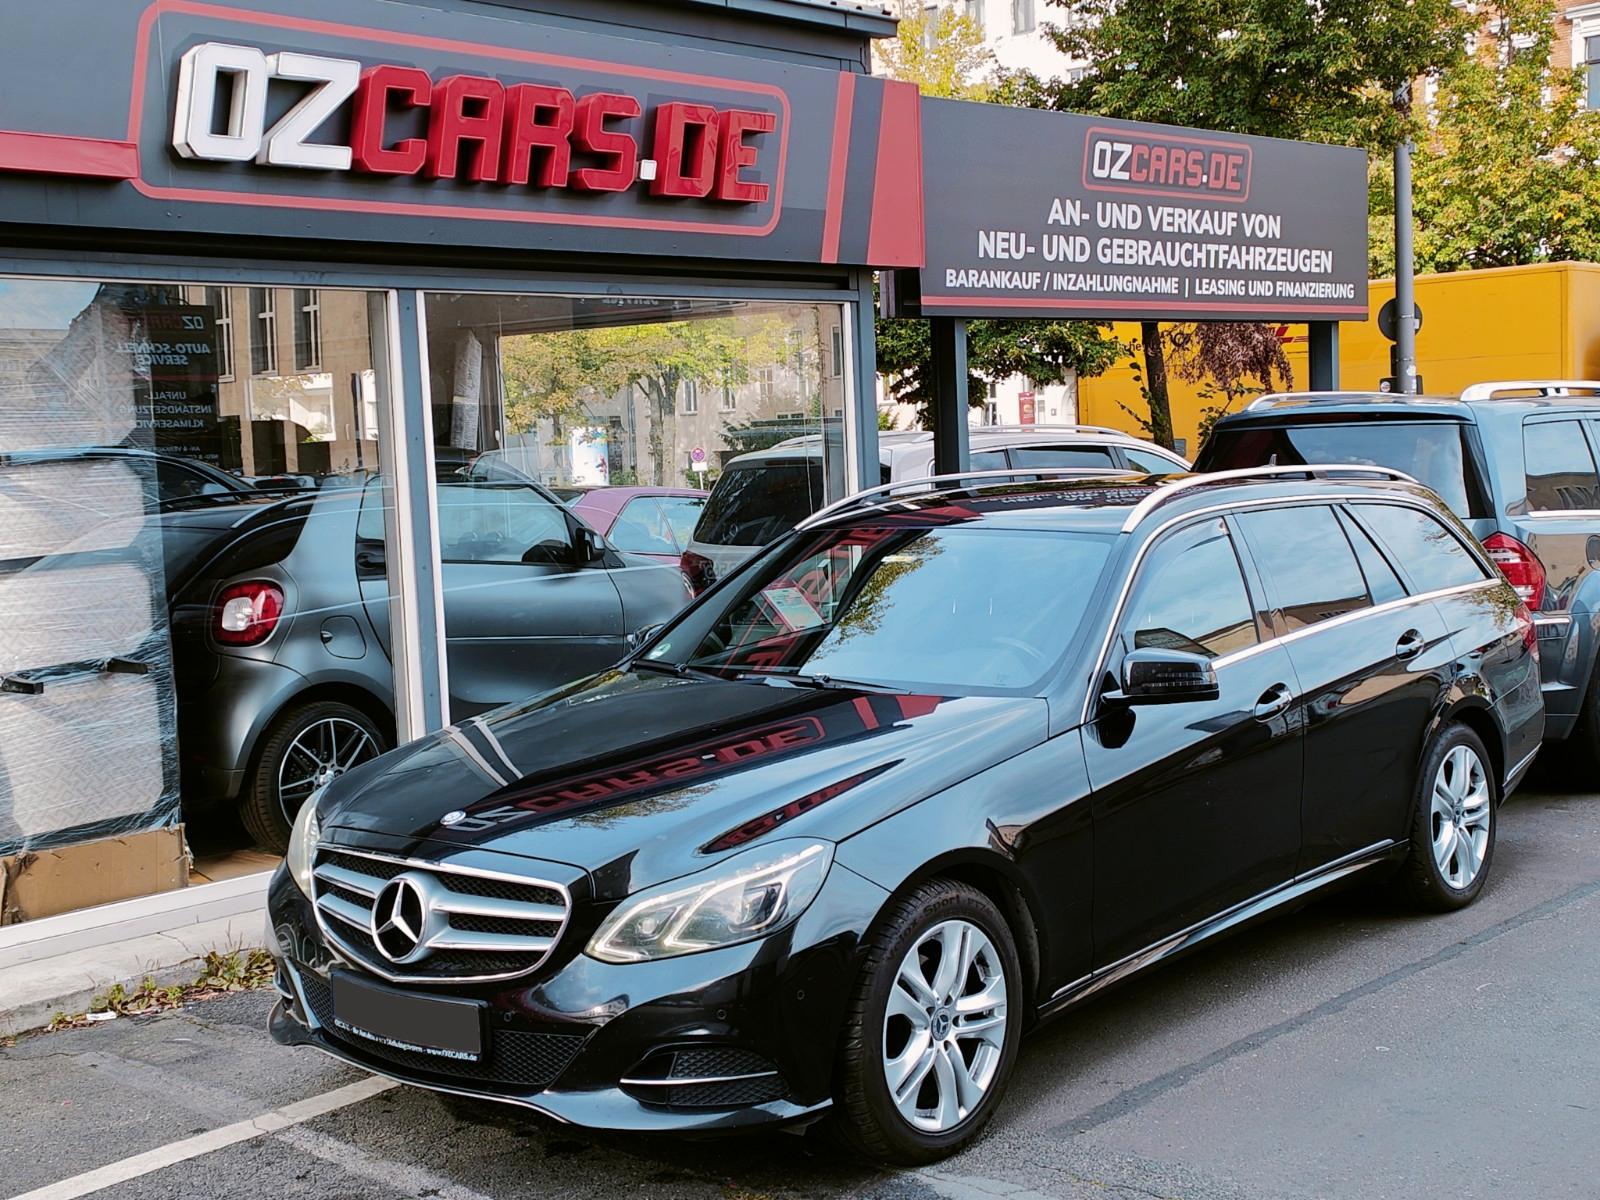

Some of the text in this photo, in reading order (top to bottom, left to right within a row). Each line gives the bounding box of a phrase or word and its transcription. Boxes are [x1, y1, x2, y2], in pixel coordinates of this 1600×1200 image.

[172, 41, 776, 204] OZCARS.DE
[1092, 140, 1244, 191] OZCARS.DE
[1047, 198, 1281, 240] AN- UND VERKAUF VON
[978, 230, 1333, 274] NEU- UND GEBRAUCHTFAHRZEUGEN
[945, 268, 1041, 291] BARANKAUF
[1052, 273, 1179, 295] INZAHLUNGNAHME
[1195, 277, 1246, 297] LEASING
[1248, 281, 1274, 298] UND
[1275, 281, 1355, 300] FINANZIERUNG
